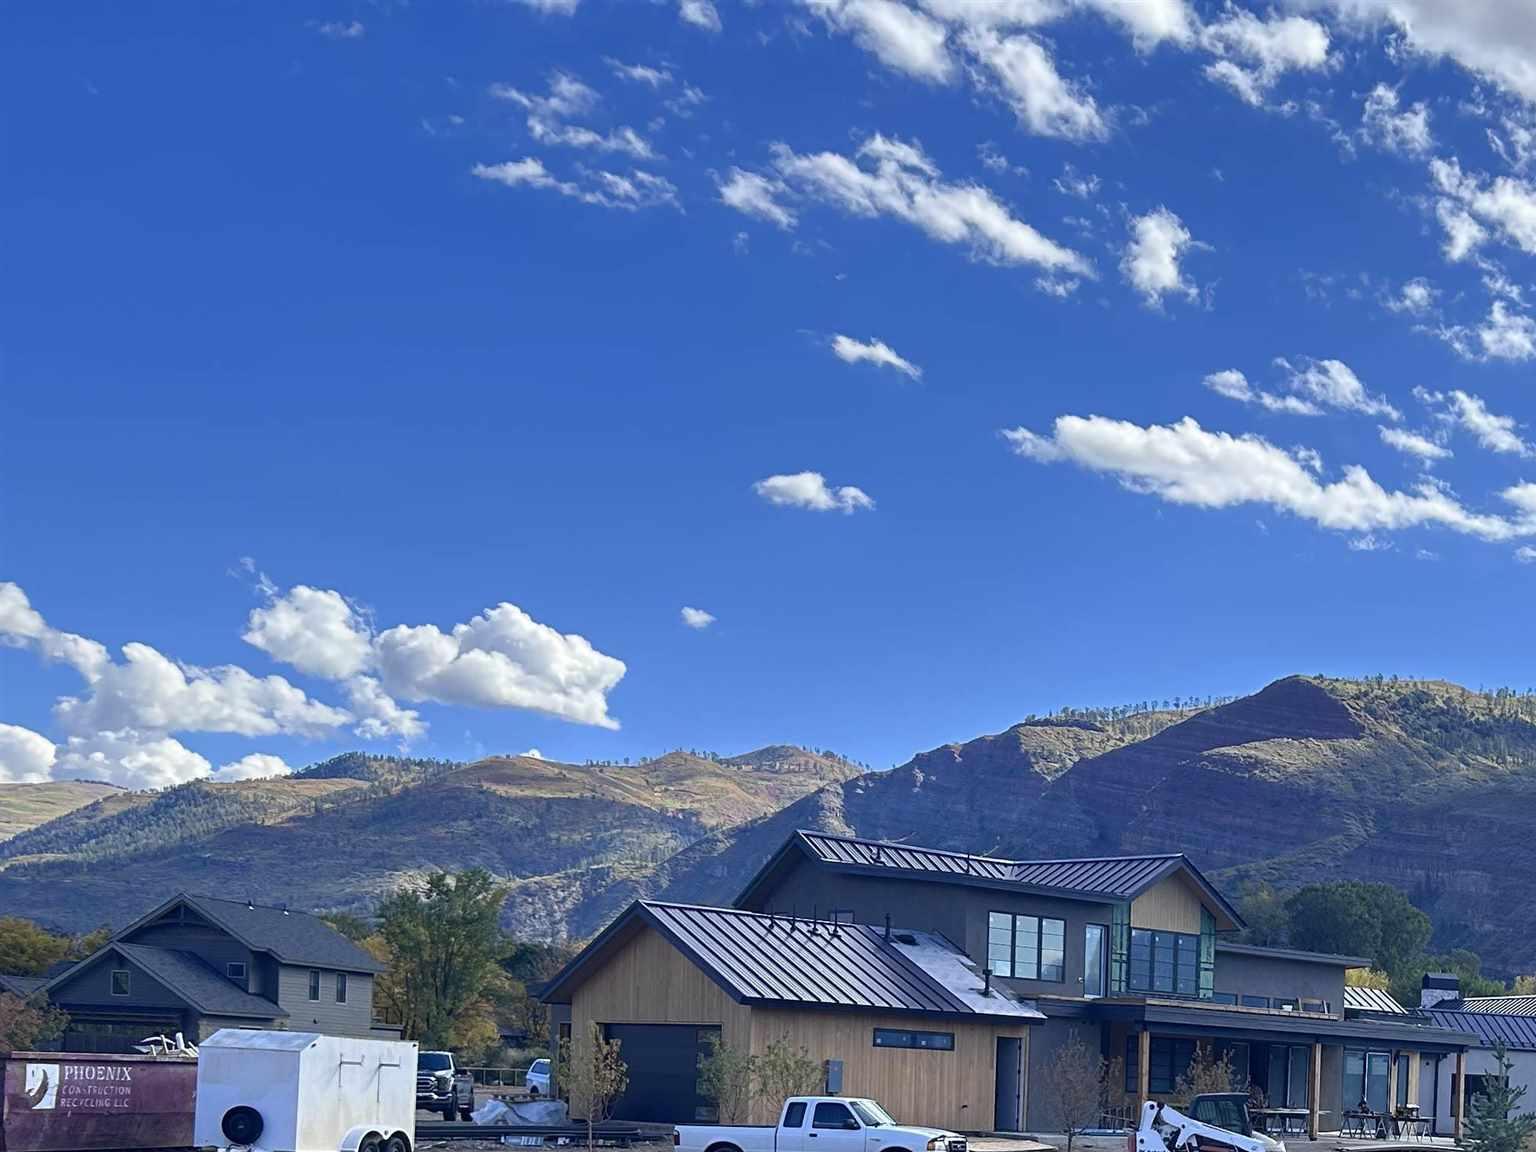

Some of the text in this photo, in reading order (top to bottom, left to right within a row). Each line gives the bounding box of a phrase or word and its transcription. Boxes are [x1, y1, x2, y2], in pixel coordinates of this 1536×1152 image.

[64, 1065, 133, 1081] PHOENIX
[60, 1097, 129, 1108] RECYCLING LLC
